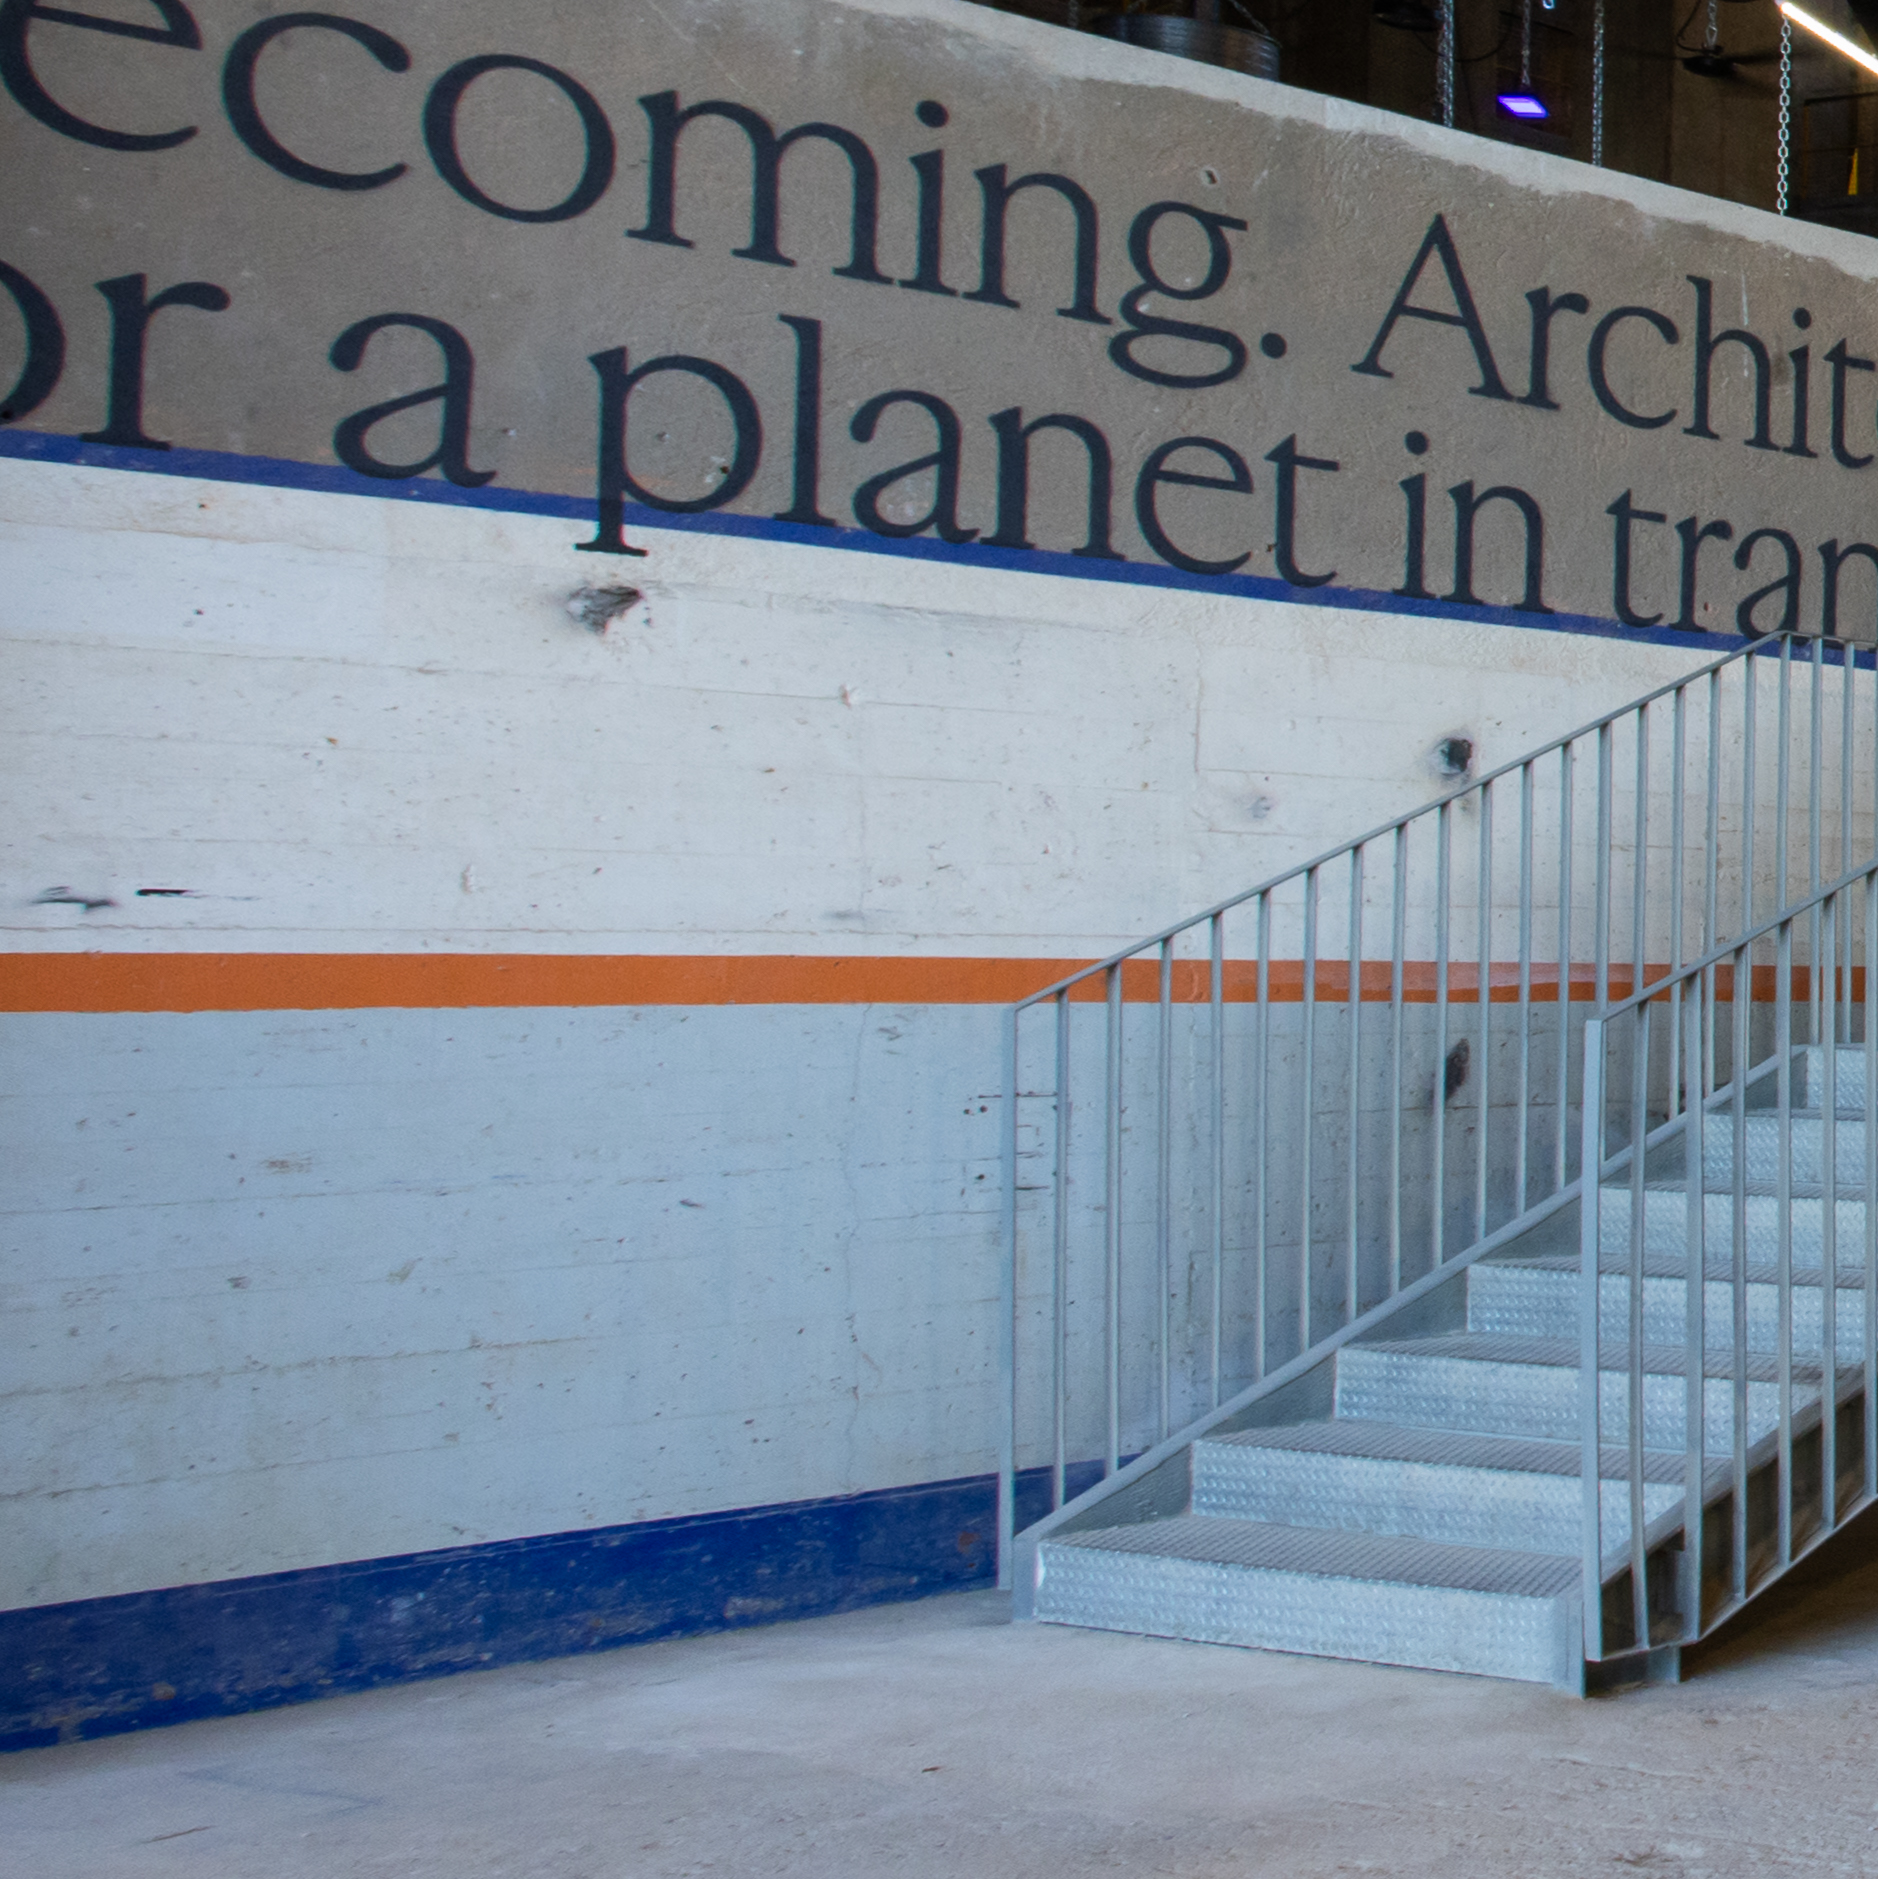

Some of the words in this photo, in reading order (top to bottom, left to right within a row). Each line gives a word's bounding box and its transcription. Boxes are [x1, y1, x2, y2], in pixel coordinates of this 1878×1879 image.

[328, 313, 497, 487] a
[574, 314, 1339, 589] planet
[1391, 430, 1555, 615] in
